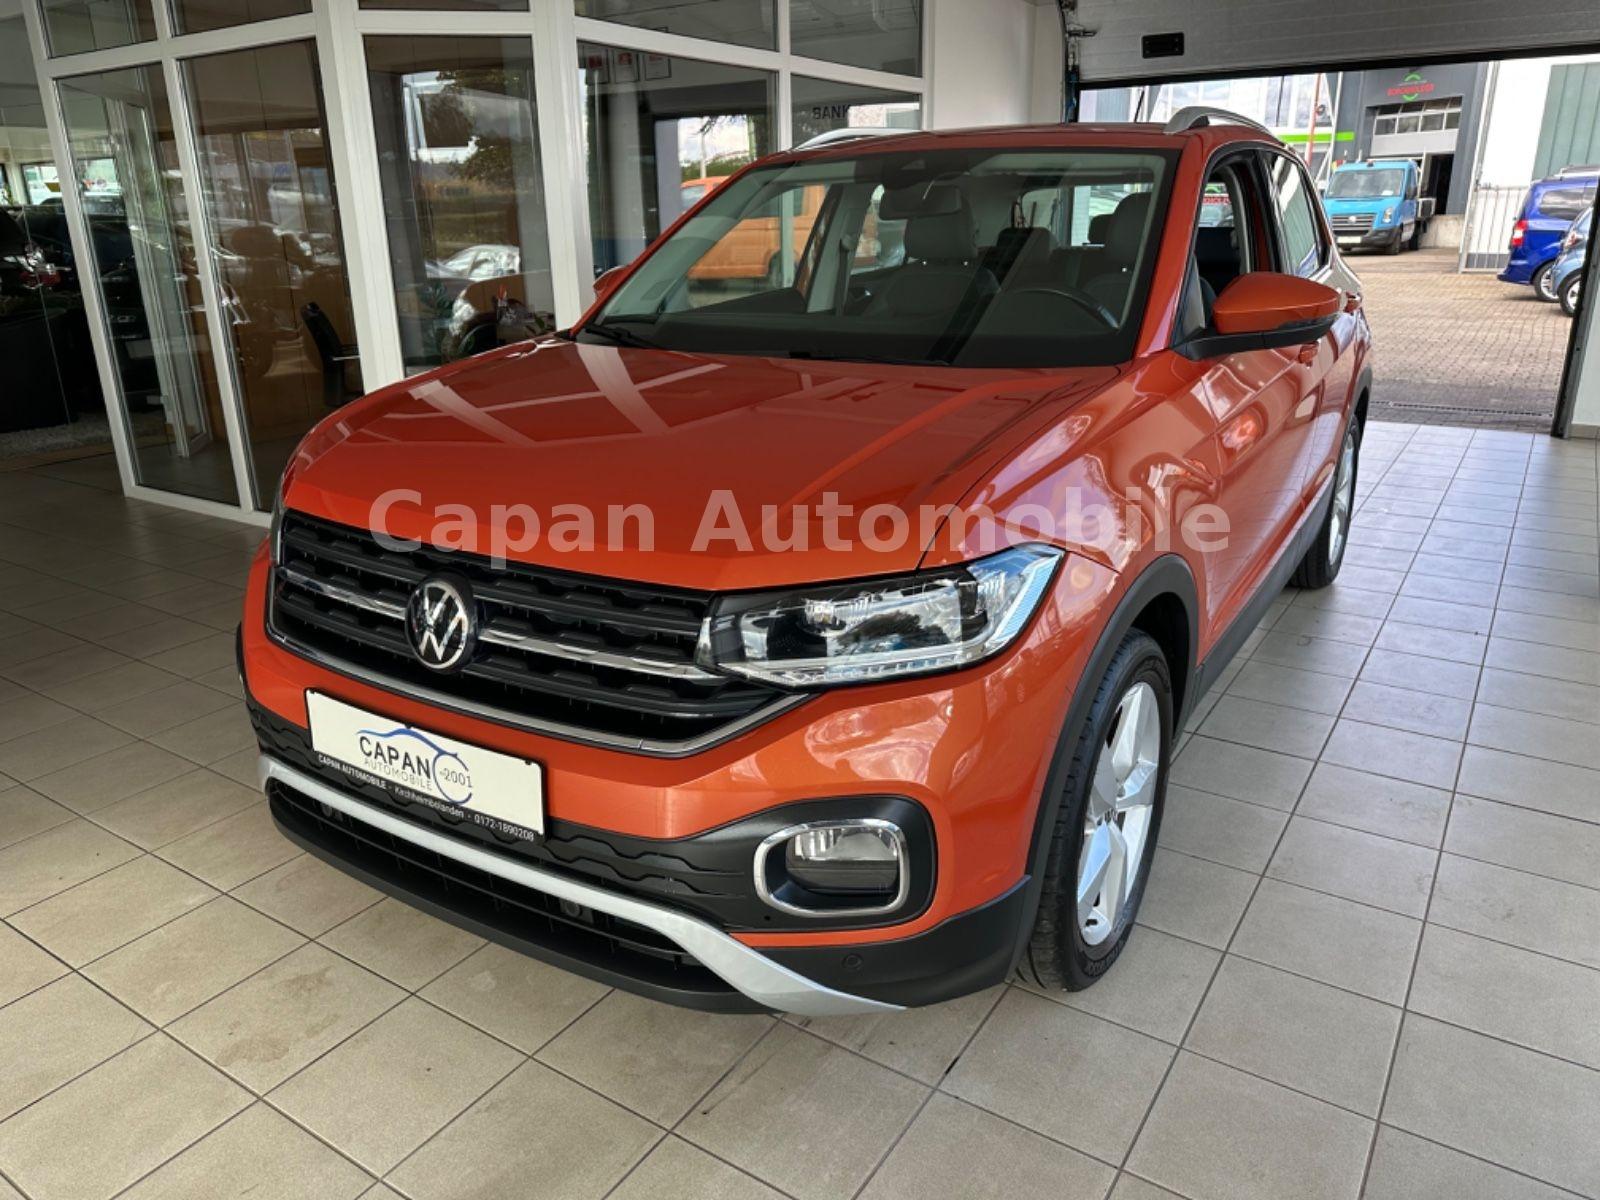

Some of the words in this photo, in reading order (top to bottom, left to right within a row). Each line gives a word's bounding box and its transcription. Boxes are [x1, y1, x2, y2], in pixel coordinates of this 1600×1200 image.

[359, 736, 431, 780] CAPAN
[364, 758, 433, 792] AUTOMOBILE
[342, 764, 387, 791] AUTOMOBILE
